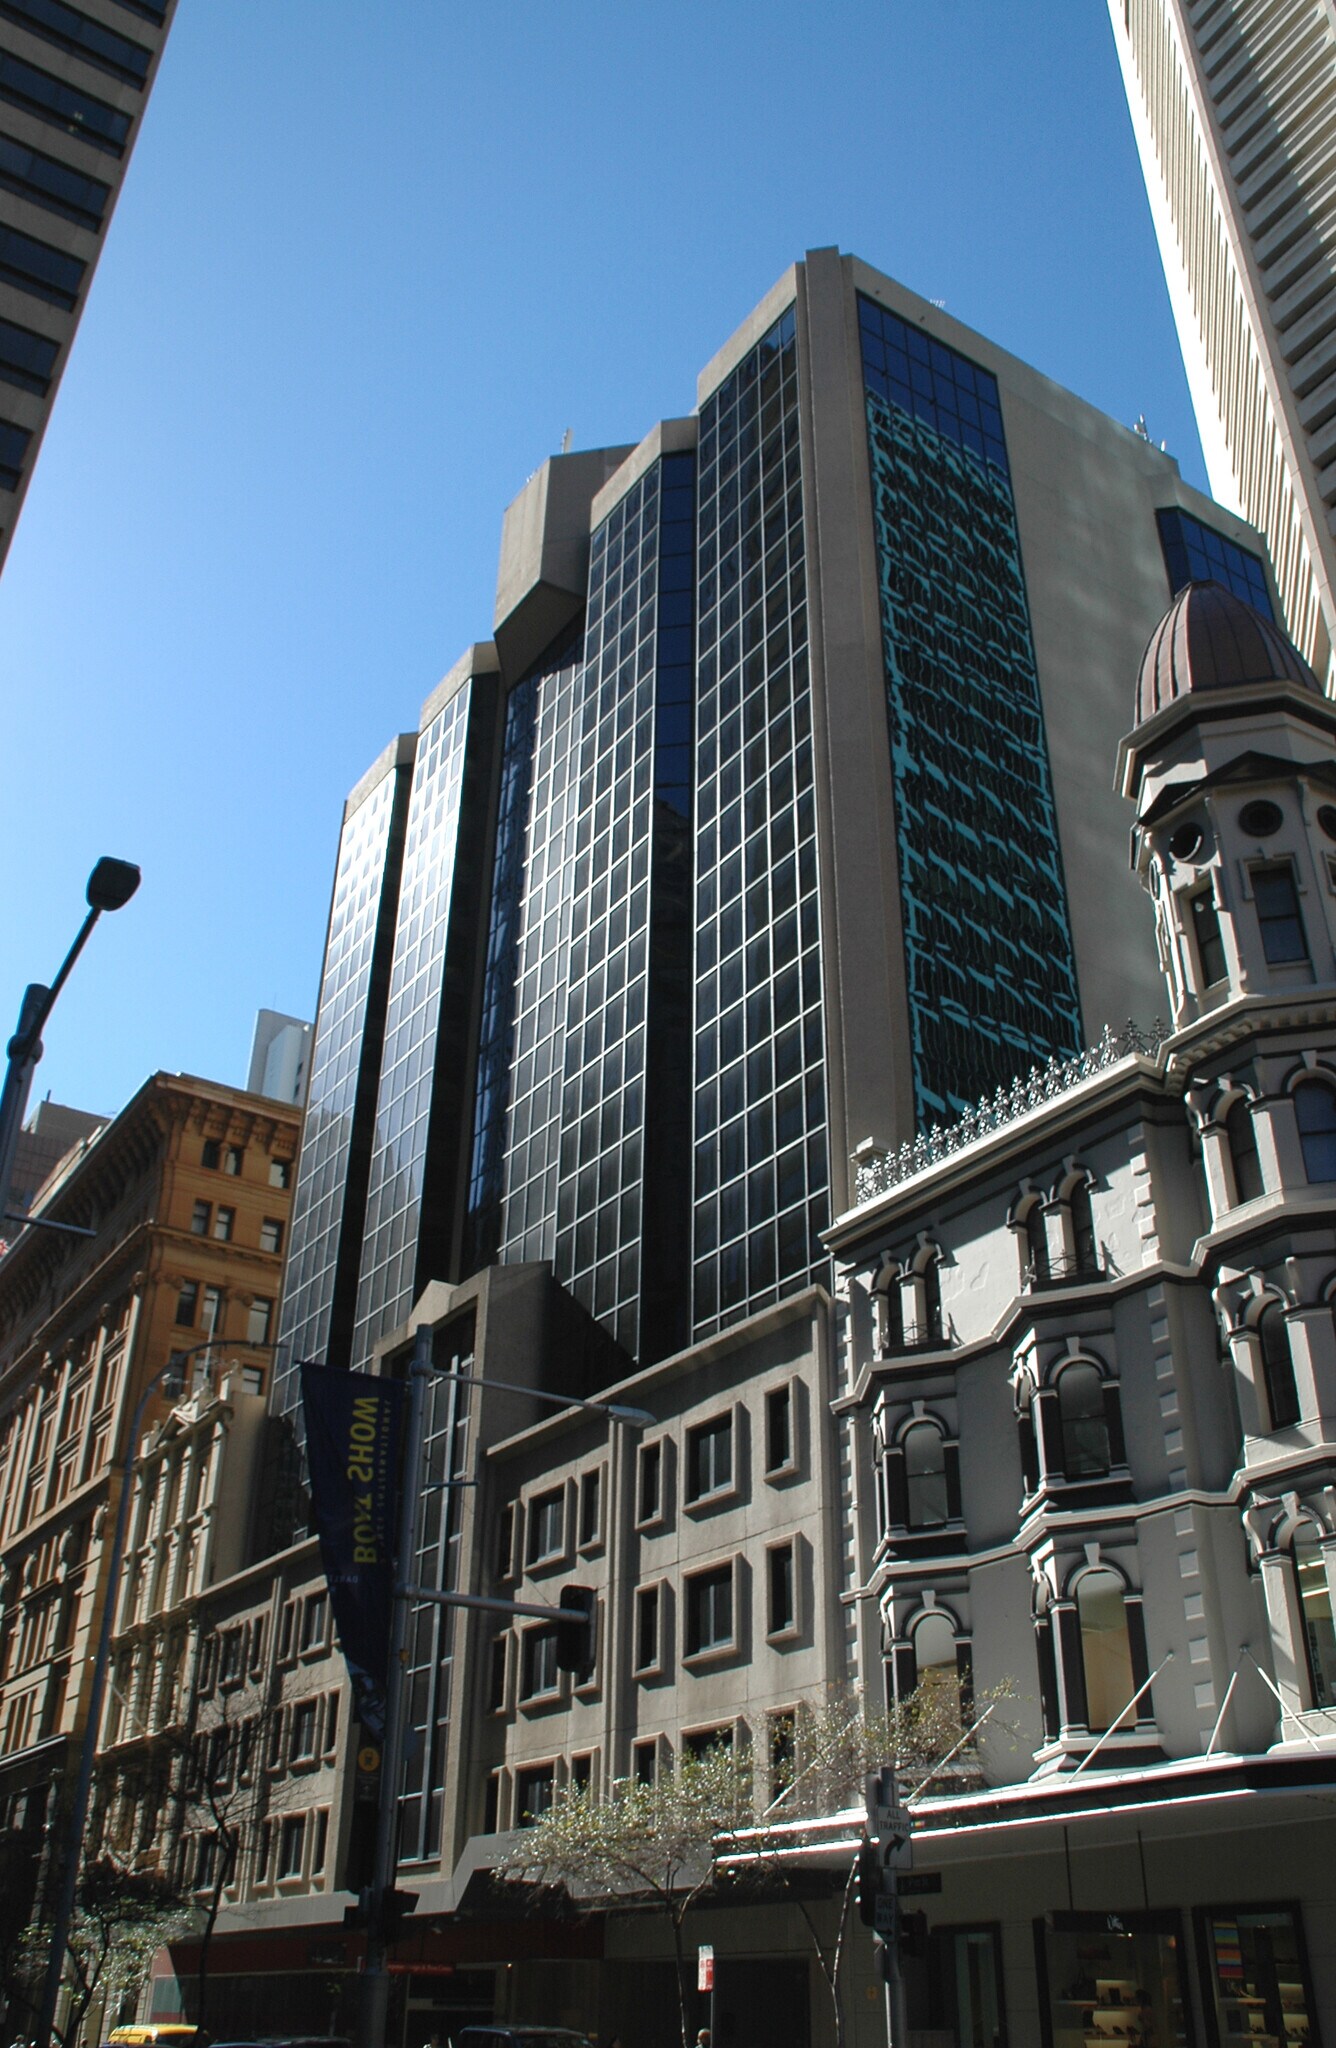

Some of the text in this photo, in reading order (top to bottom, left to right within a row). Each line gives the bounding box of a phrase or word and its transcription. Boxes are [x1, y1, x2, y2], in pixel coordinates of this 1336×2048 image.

[886, 1809, 900, 1820] ALL
[879, 1820, 909, 1832] TRAFFIC
[877, 1898, 893, 1909] ONE
[876, 1914, 894, 1926] WAY
